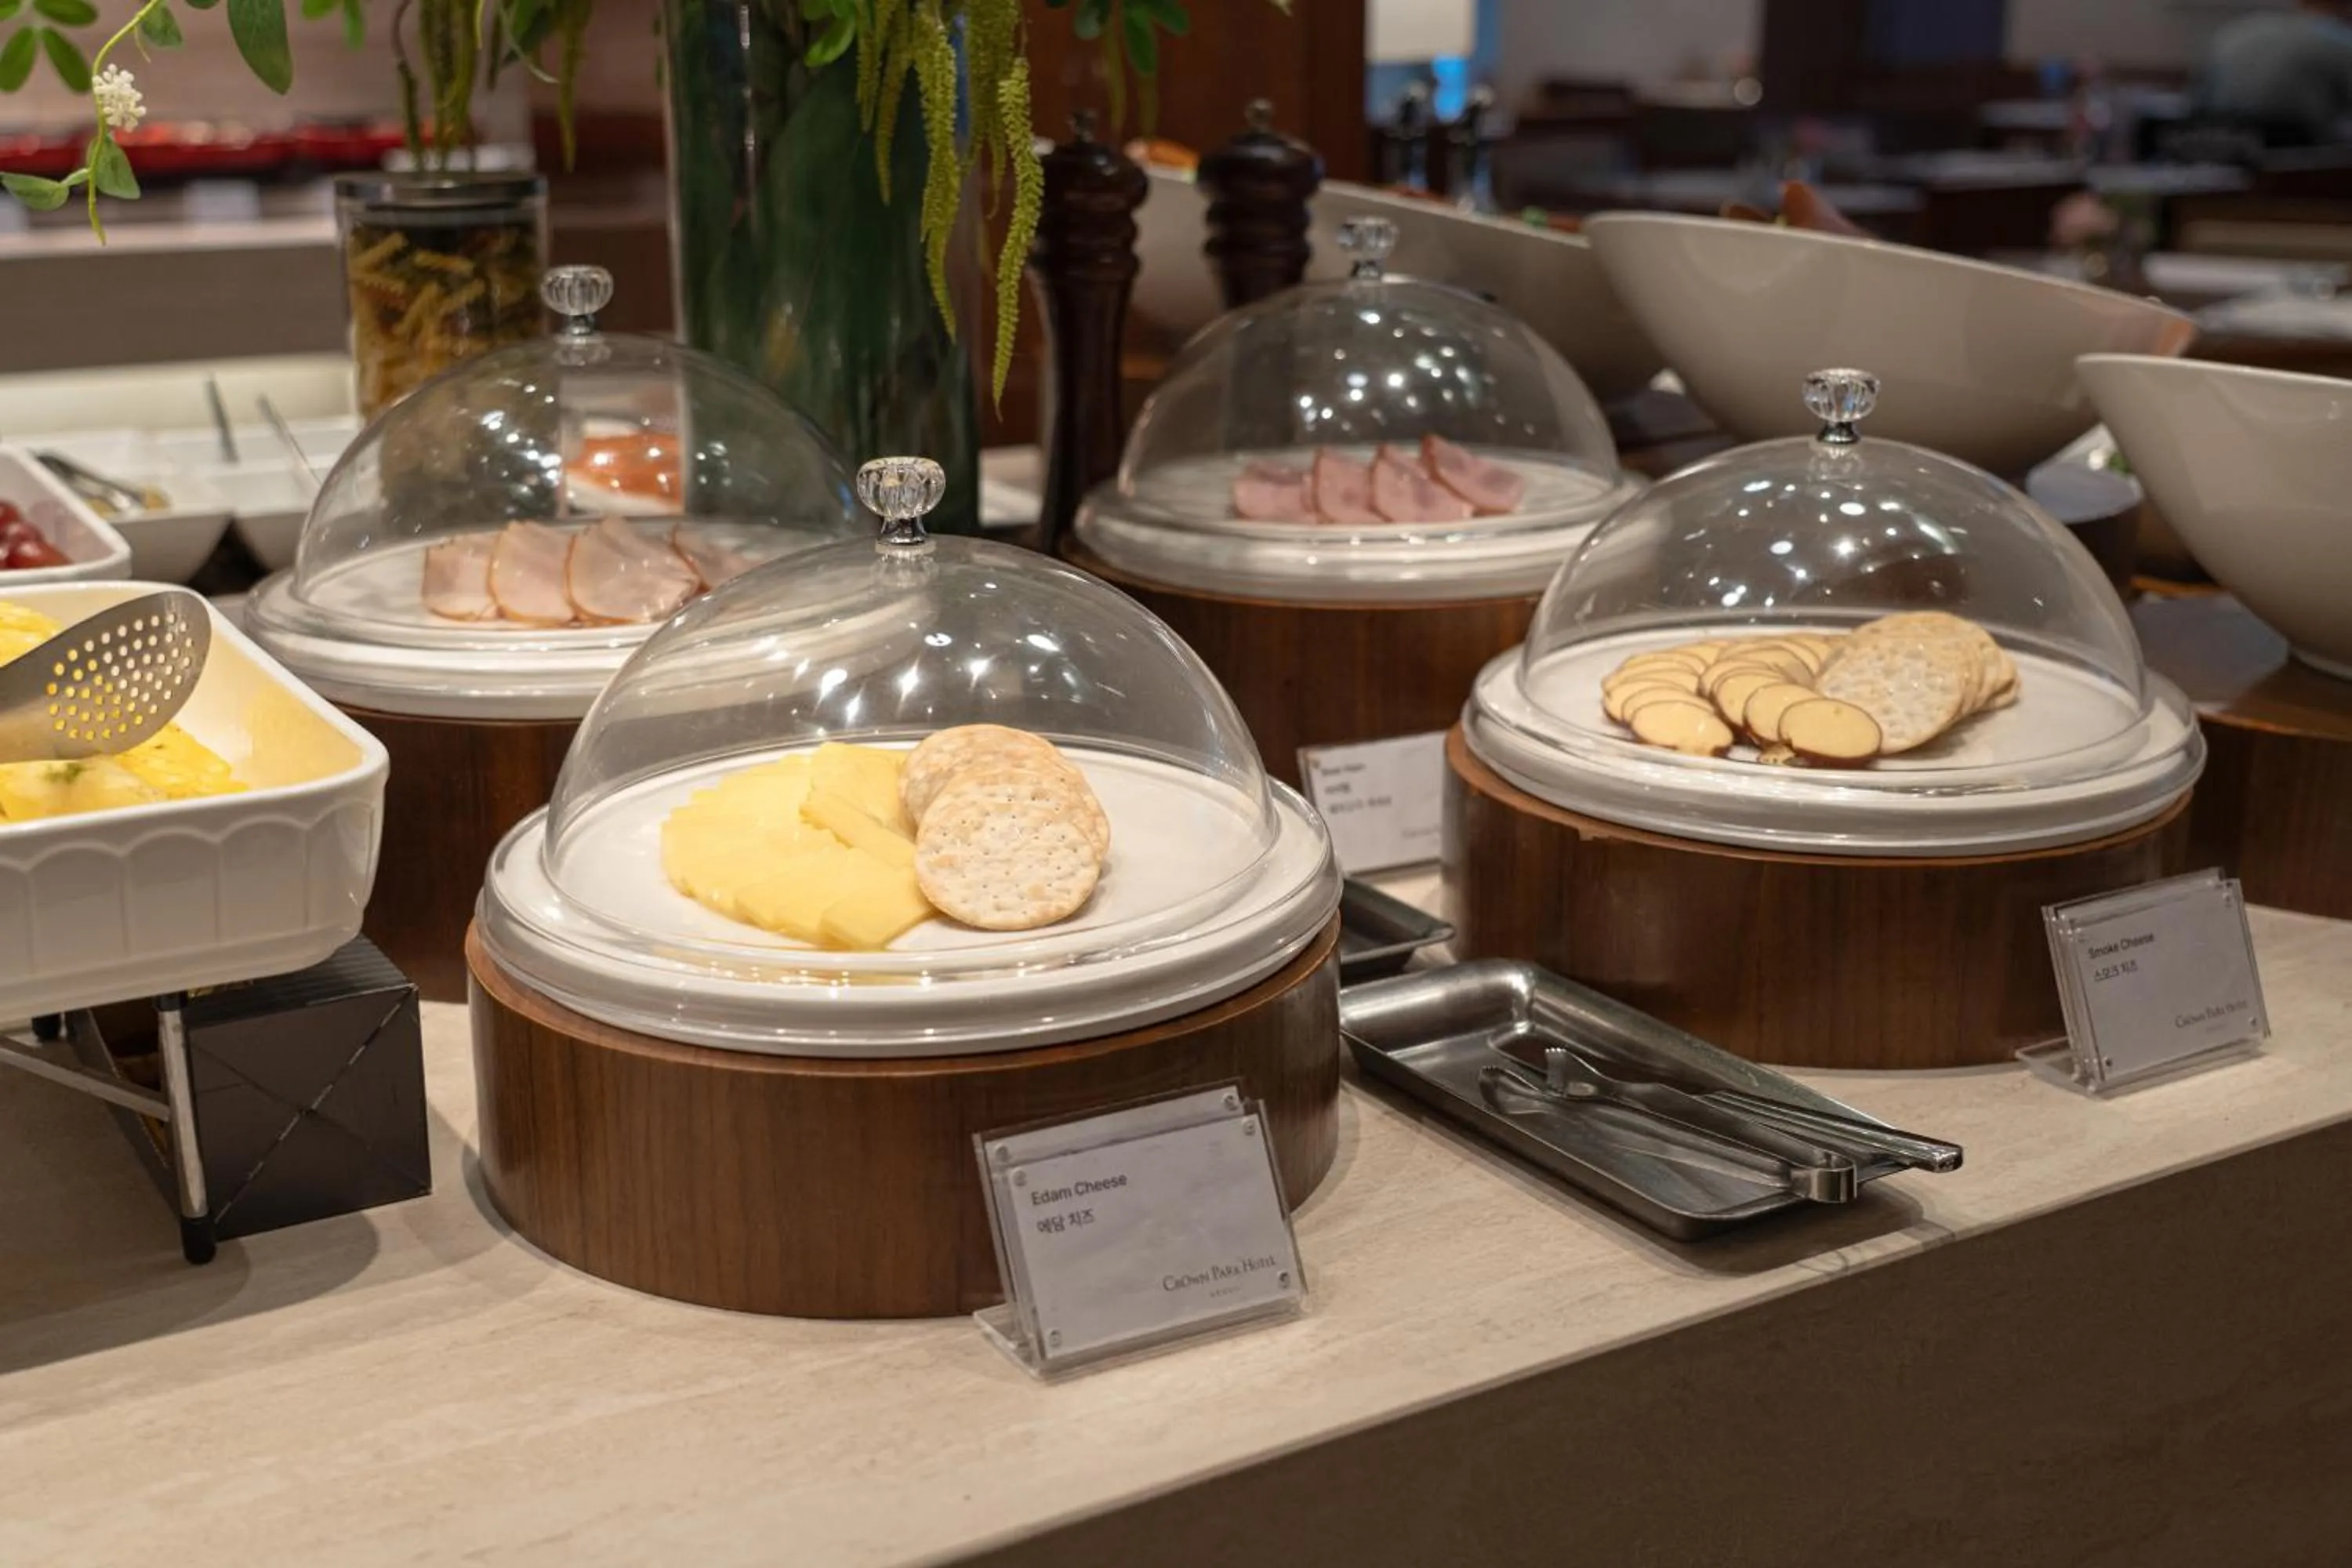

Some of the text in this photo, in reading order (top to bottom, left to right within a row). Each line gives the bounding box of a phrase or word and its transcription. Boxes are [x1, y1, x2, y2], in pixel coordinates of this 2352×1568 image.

[1031, 1174, 1127, 1205] Edam Cheese
[1068, 1208, 1095, 1229] 치즈
